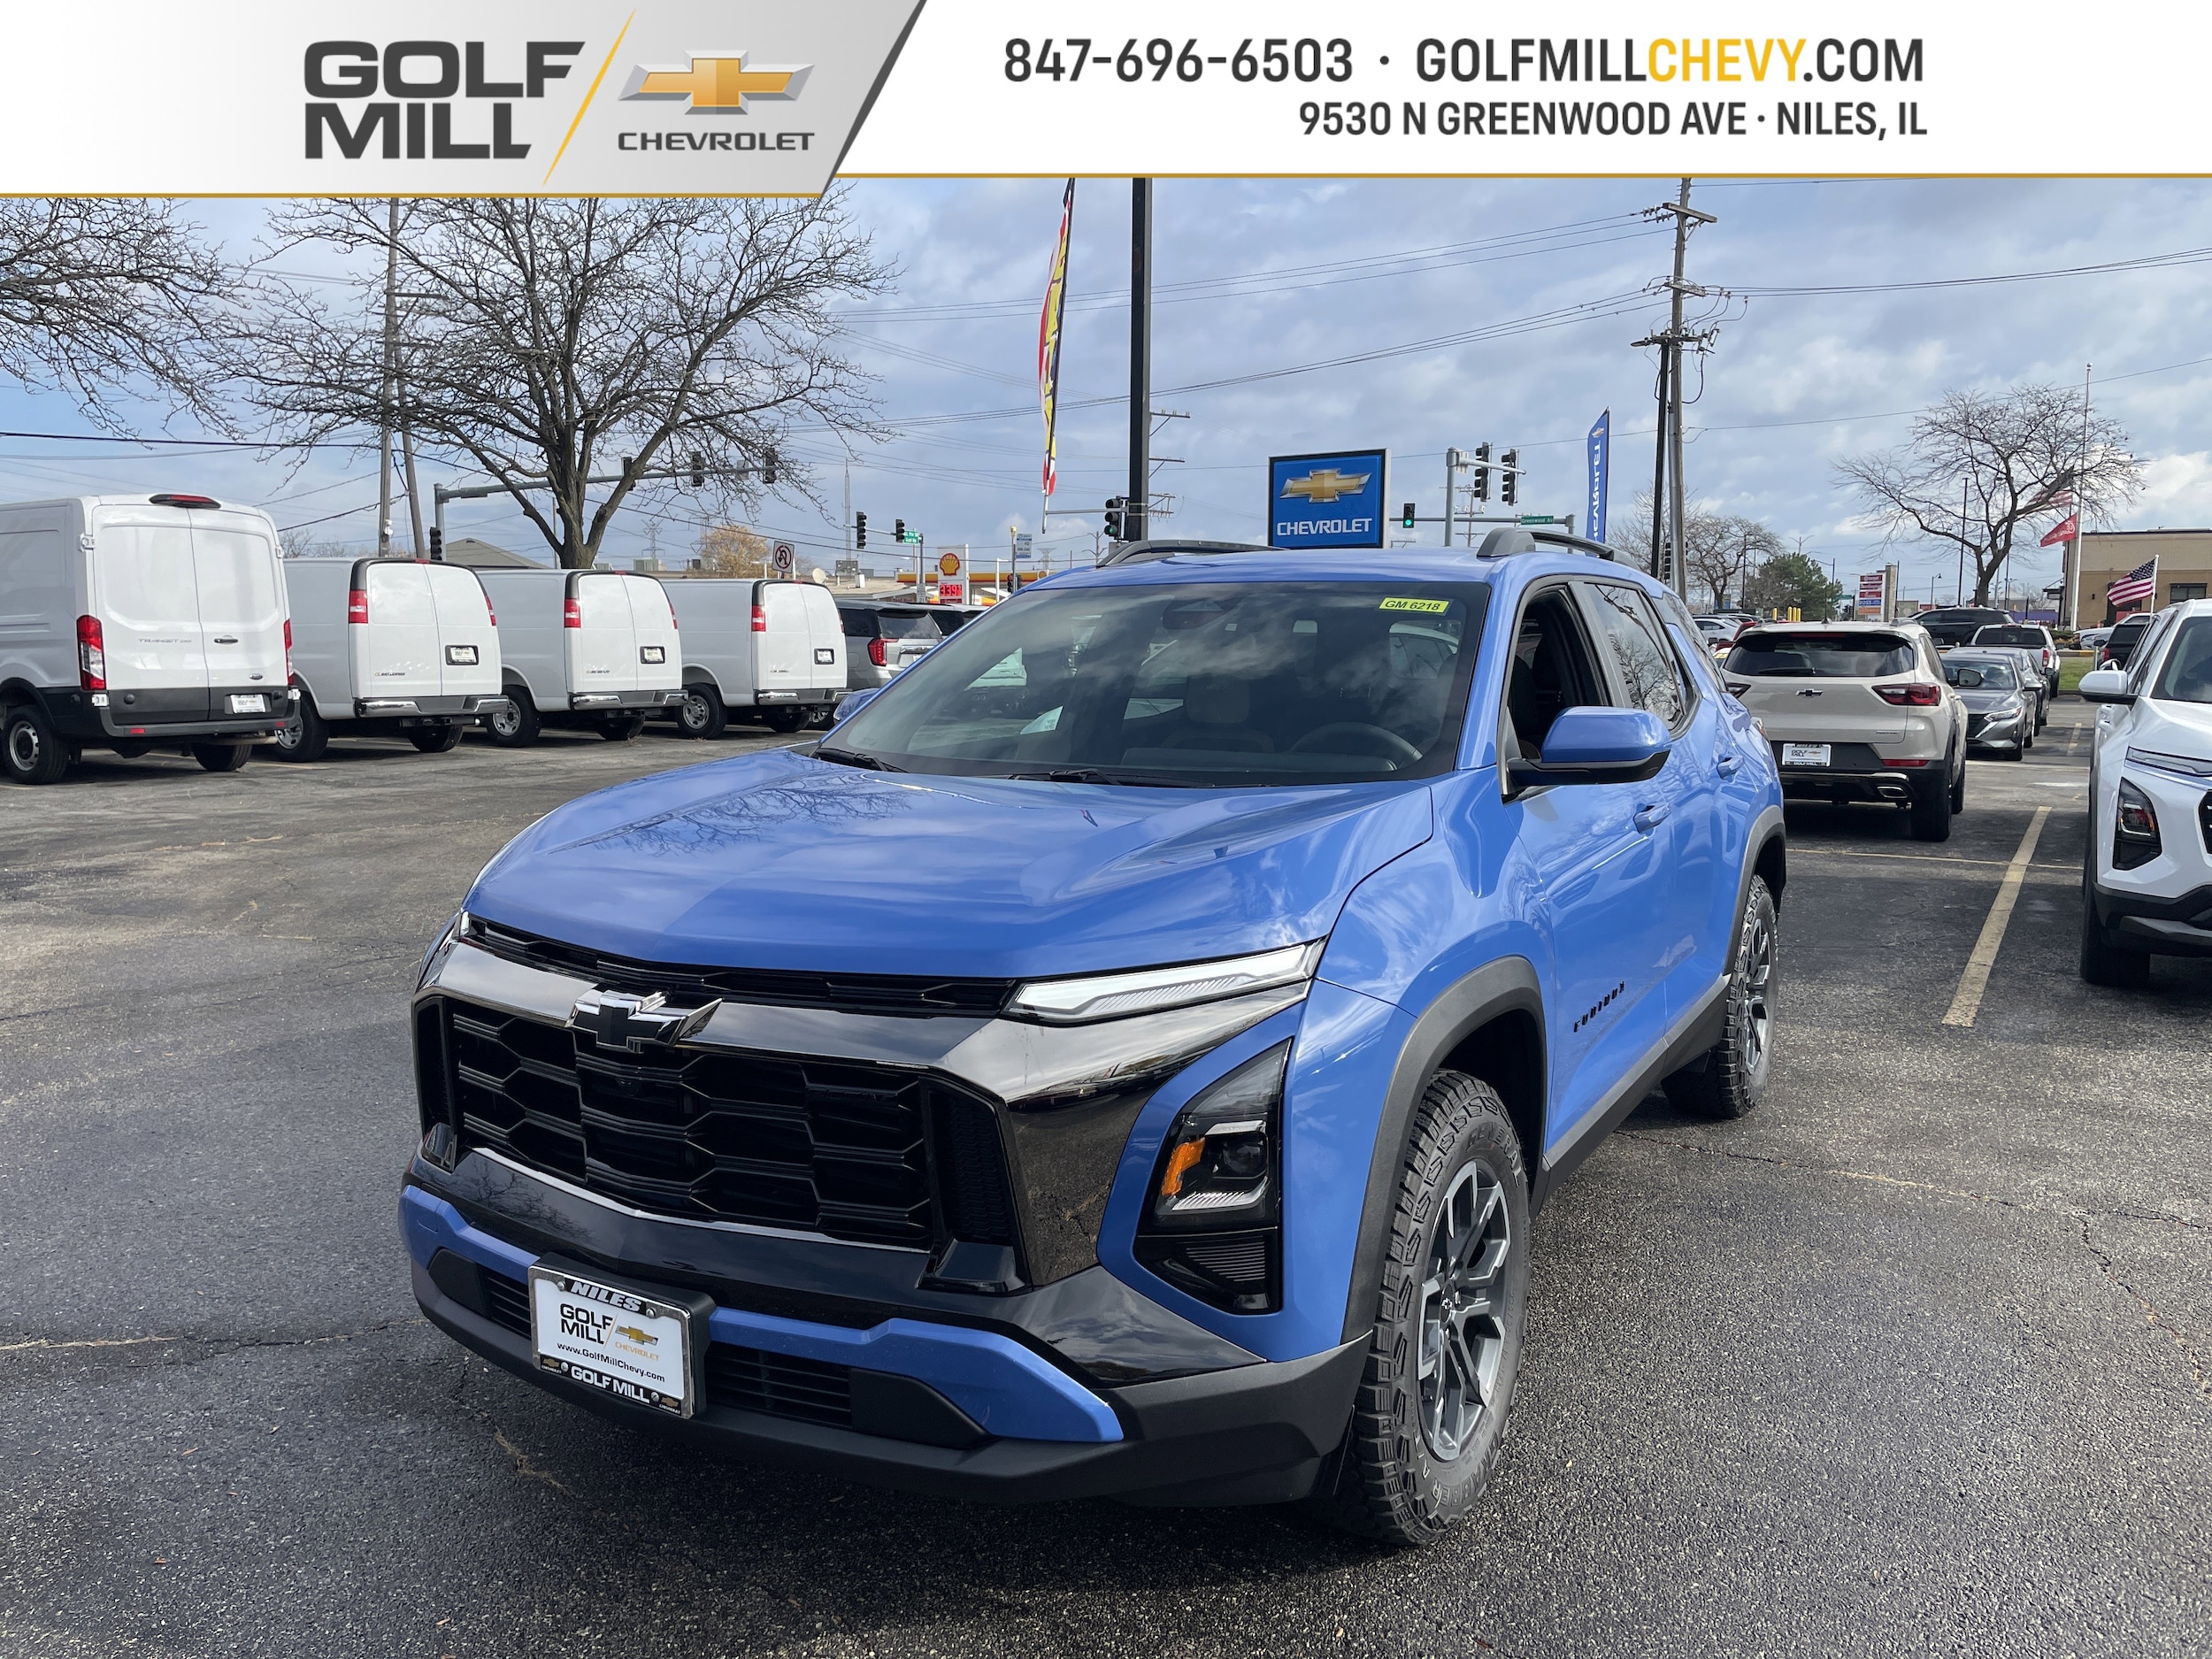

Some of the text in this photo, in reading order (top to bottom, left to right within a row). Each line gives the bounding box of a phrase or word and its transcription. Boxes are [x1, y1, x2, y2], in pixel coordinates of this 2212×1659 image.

[1277, 518, 1372, 535] CHEVROLET
[1384, 600, 1440, 611] GM 6218
[570, 1280, 641, 1312] NILES
[559, 1303, 613, 1330] GOLF
[561, 1318, 605, 1345] MILL
[557, 1342, 665, 1383] www.GolfMillChevy.com
[614, 1340, 660, 1362] CHEVROLET
[571, 1364, 650, 1404] GOLF MILL
